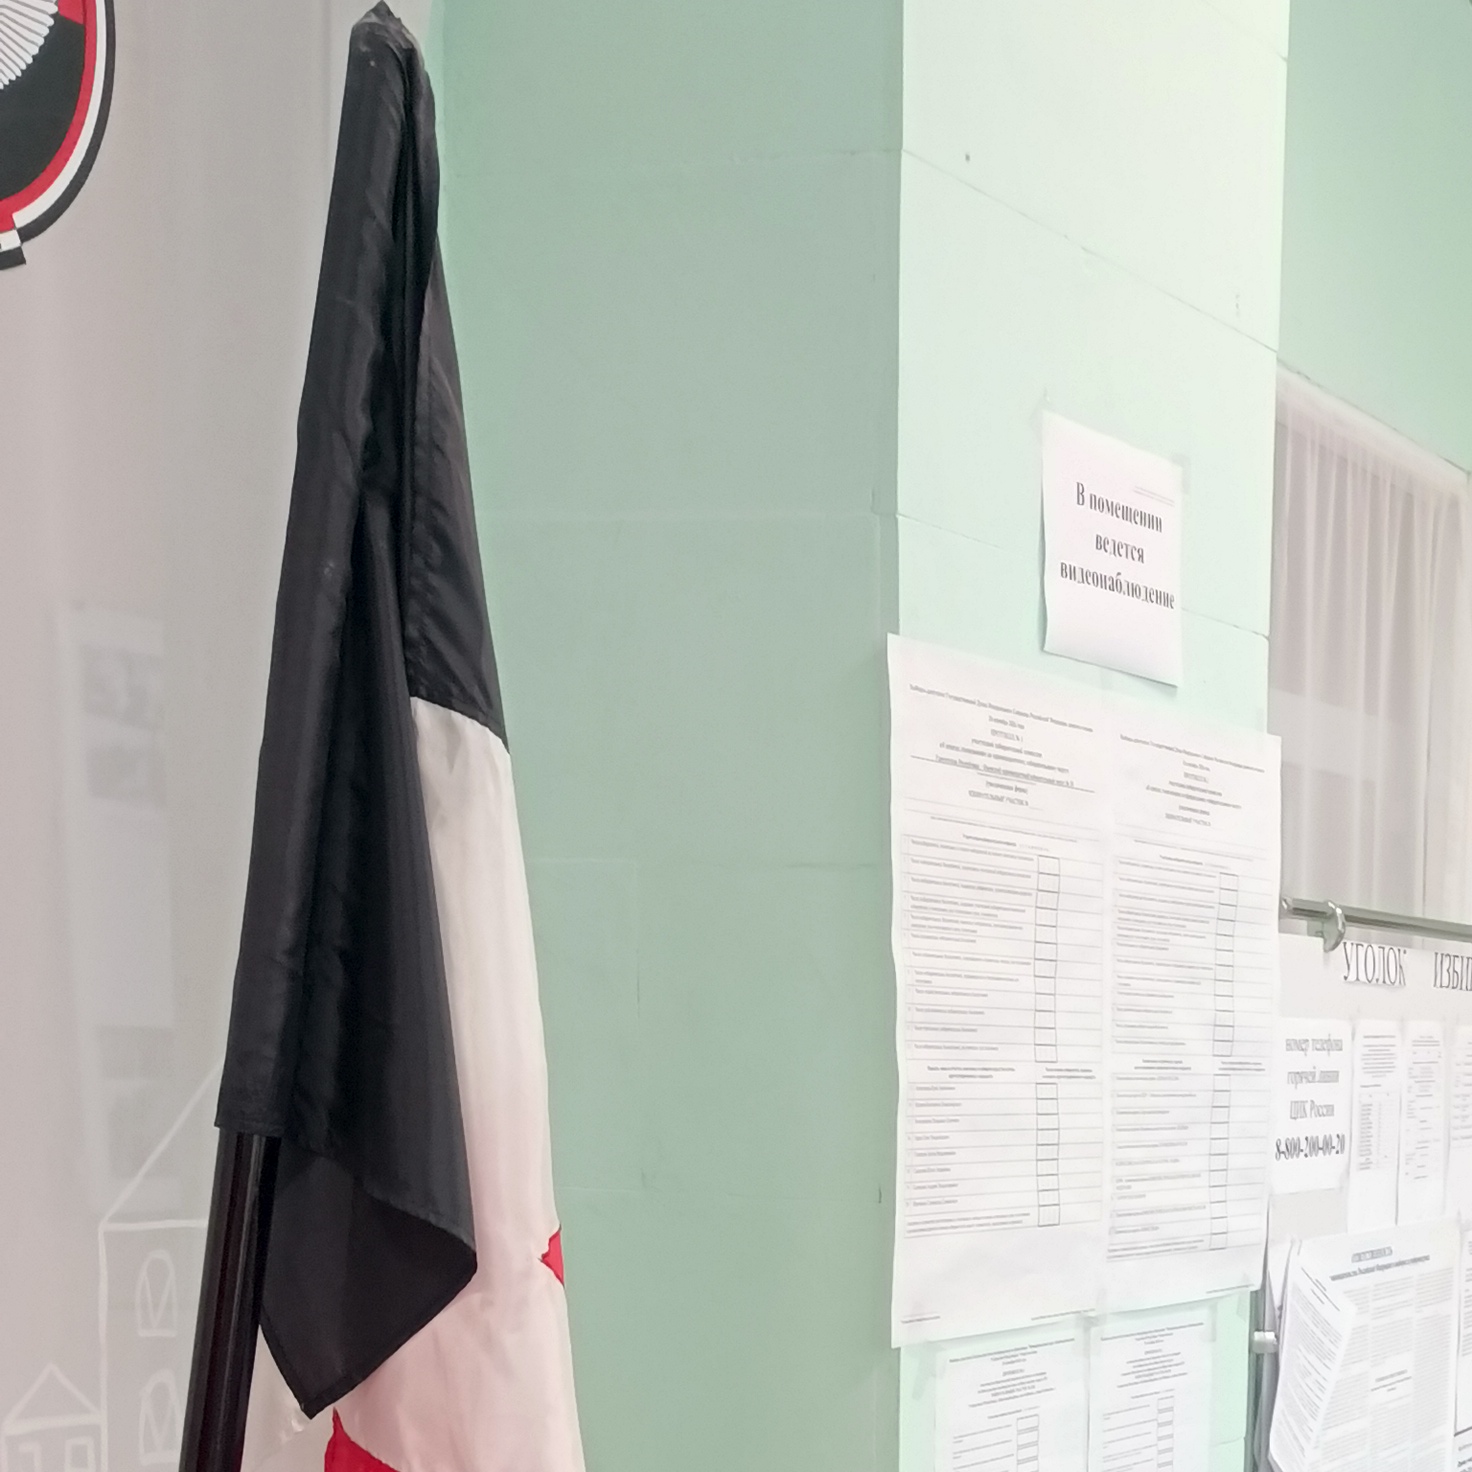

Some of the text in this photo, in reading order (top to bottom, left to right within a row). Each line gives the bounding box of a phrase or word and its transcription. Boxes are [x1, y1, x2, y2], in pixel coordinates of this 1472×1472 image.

[1076, 482, 1085, 506] В
[1089, 493, 1163, 533] помещении
[1095, 534, 1145, 564] ведется
[1060, 562, 1175, 609] видеонаблюдение
[1342, 941, 1407, 986] УГОЛОК
[1275, 1133, 1346, 1161] 8-800-200-00-20
